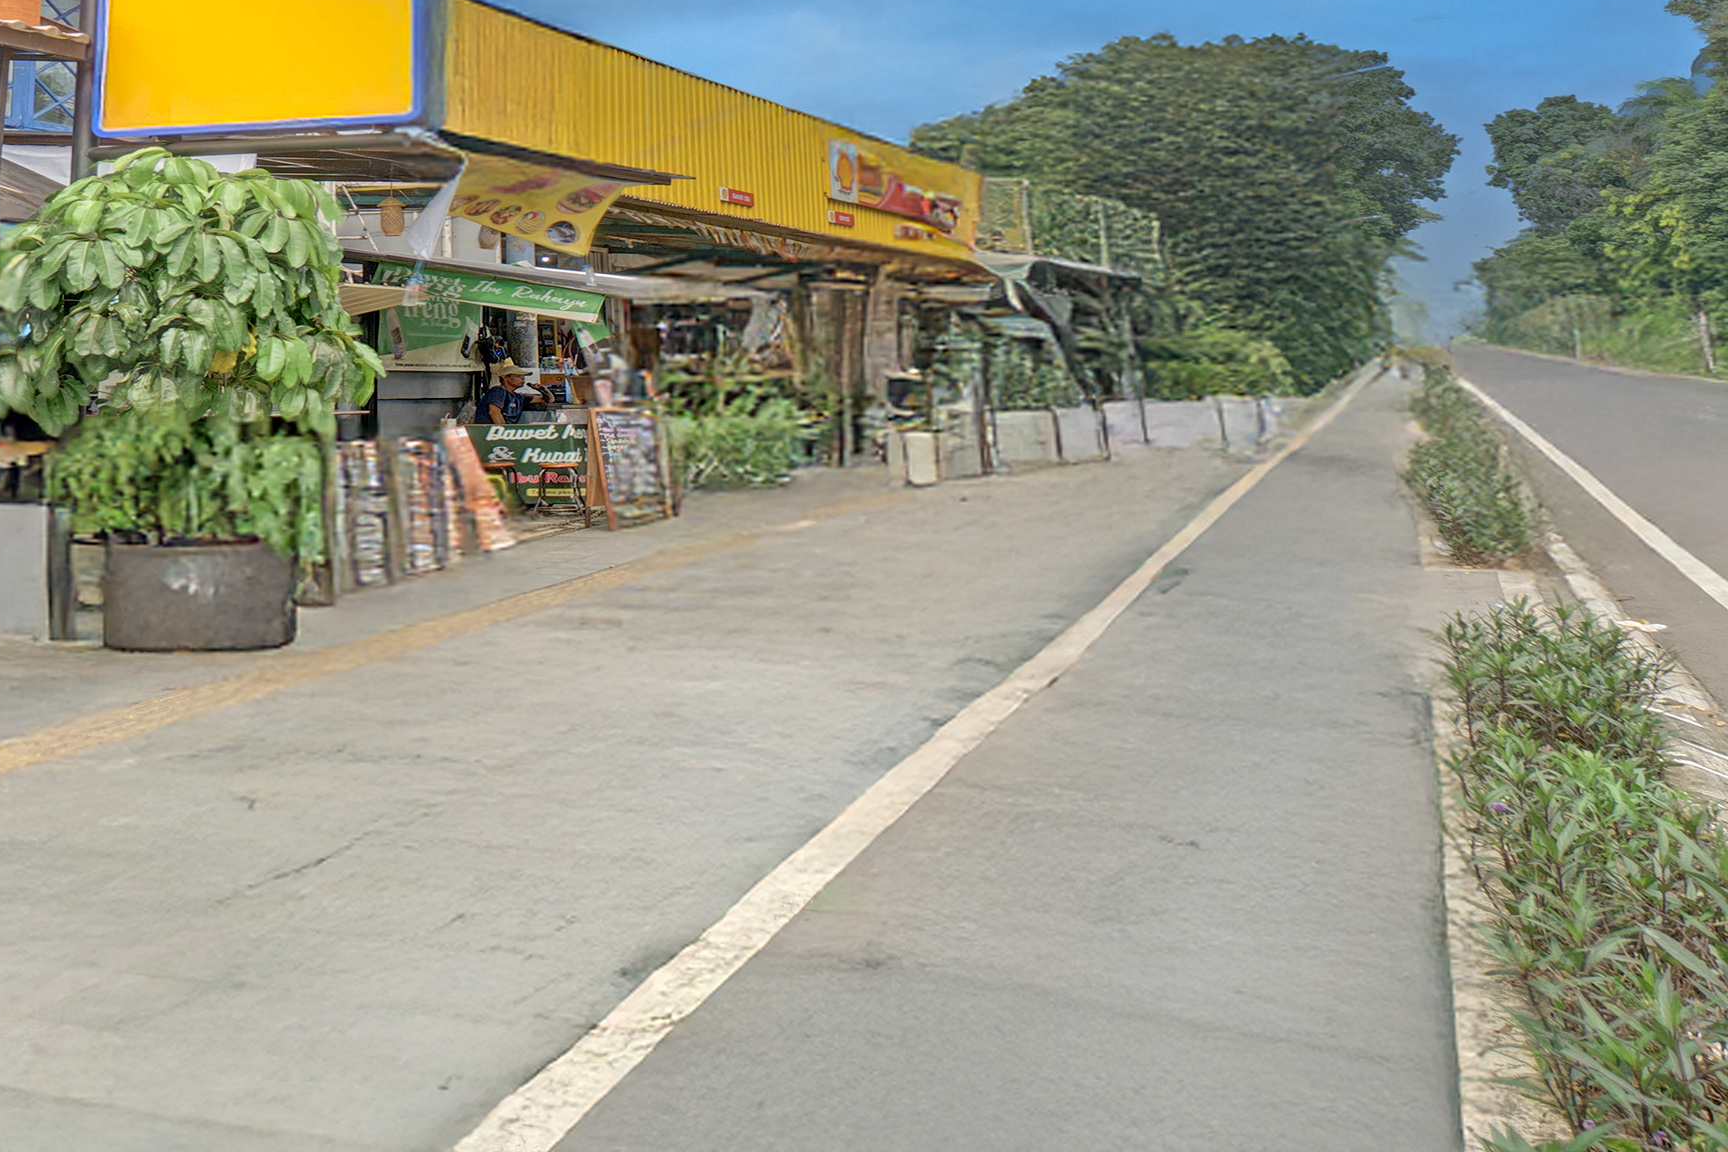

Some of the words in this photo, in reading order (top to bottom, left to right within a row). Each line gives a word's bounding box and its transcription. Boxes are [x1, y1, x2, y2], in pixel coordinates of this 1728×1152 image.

[470, 280, 503, 295] Ibu
[511, 285, 588, 311] Rahayu
[485, 424, 559, 441] Dawet
[487, 445, 517, 463] &
[508, 471, 540, 484] Ibu
